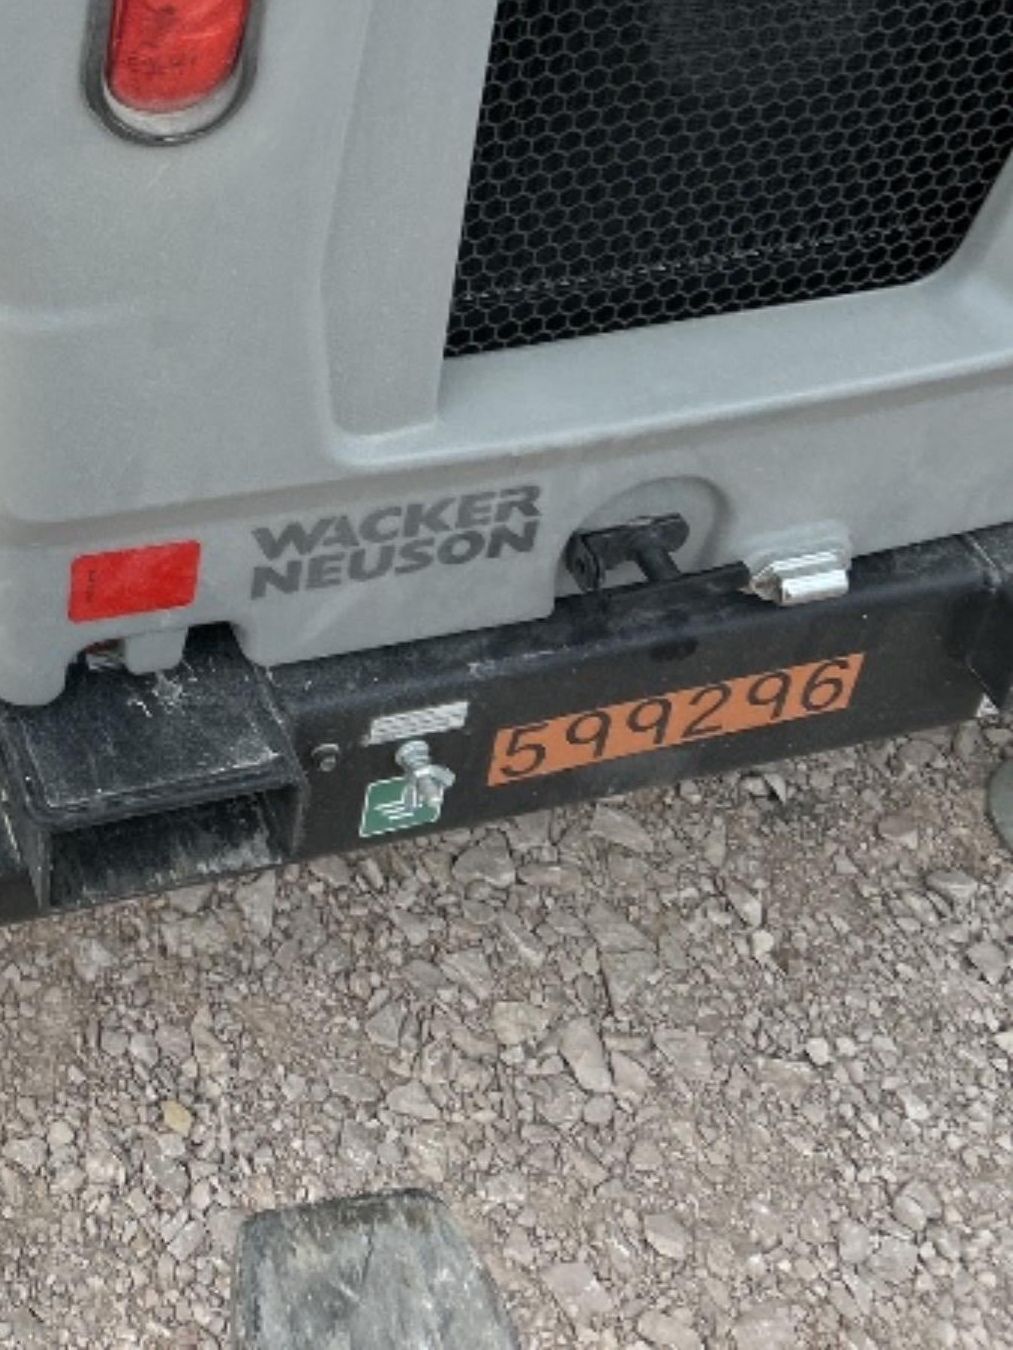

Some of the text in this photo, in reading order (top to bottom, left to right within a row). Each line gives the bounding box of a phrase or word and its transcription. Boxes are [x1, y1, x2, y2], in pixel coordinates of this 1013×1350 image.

[250, 520, 540, 600] NEUSON
[251, 486, 542, 561] WACKER
[499, 658, 851, 778] 599296
